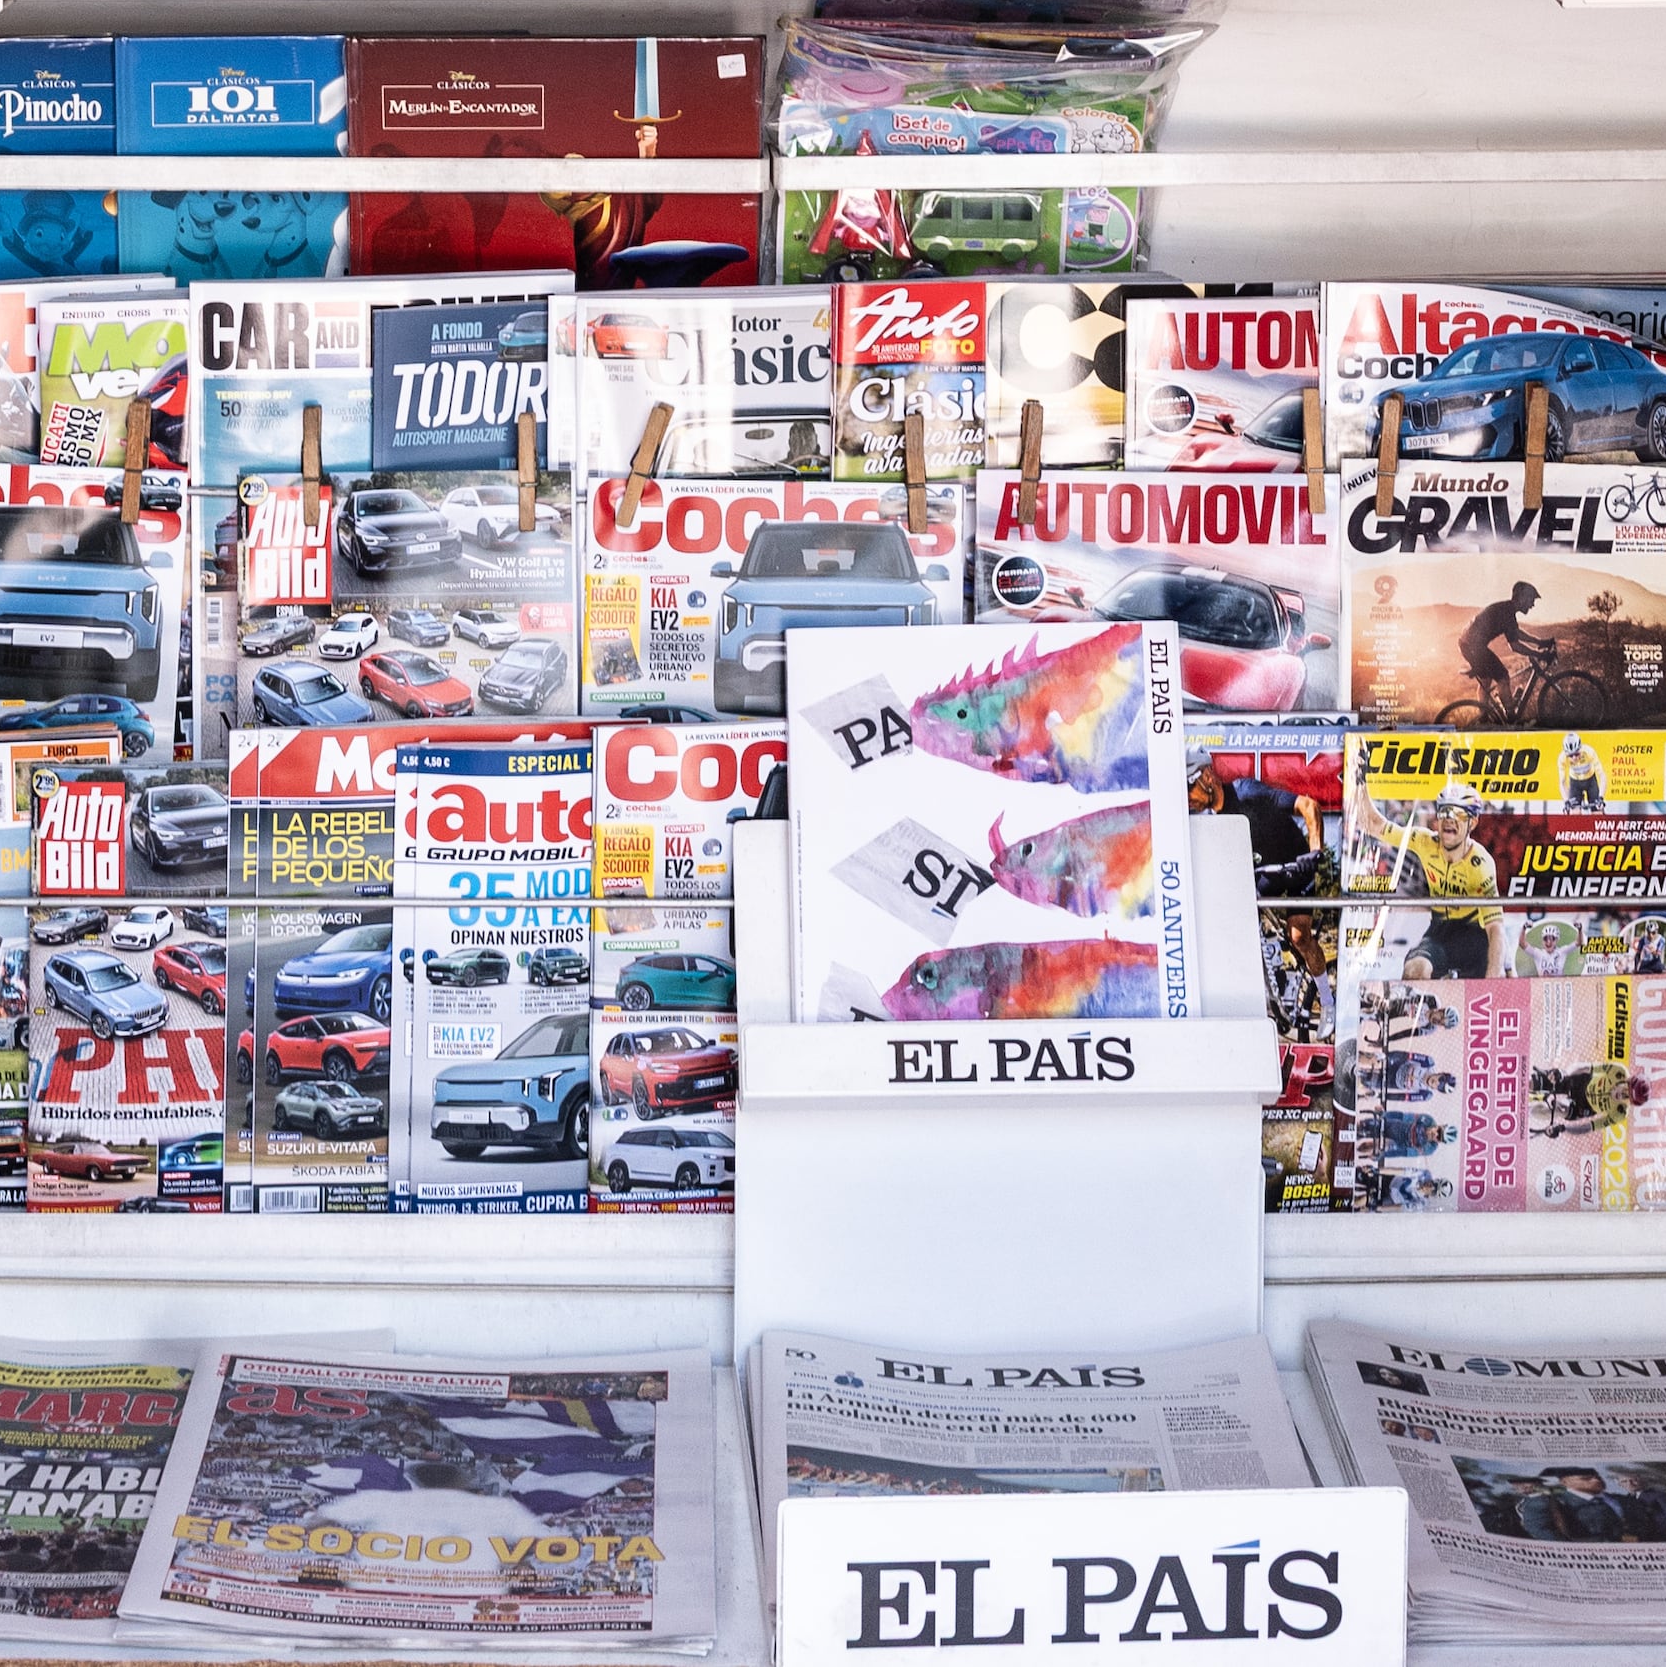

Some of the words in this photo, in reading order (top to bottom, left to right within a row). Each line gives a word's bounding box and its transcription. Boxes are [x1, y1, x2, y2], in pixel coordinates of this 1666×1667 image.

[187, 110, 280, 124] DÁLMATAS
[1411, 473, 1509, 492] Mundo
[1348, 496, 1614, 554] GRAVEL
[42, 790, 121, 842] Auto
[45, 846, 119, 890] Bild
[1519, 845, 1641, 878] JUSTICIA
[271, 912, 362, 925] VOLKSWAGEN
[887, 1040, 977, 1083] EL
[989, 1032, 1134, 1082] PAÍS
[174, 1515, 249, 1547] EL
[263, 1526, 472, 1563] SOCIO
[489, 1534, 665, 1562] VOTA
[847, 1560, 1024, 1649] EL
[1051, 1540, 1342, 1644] PAÍS
